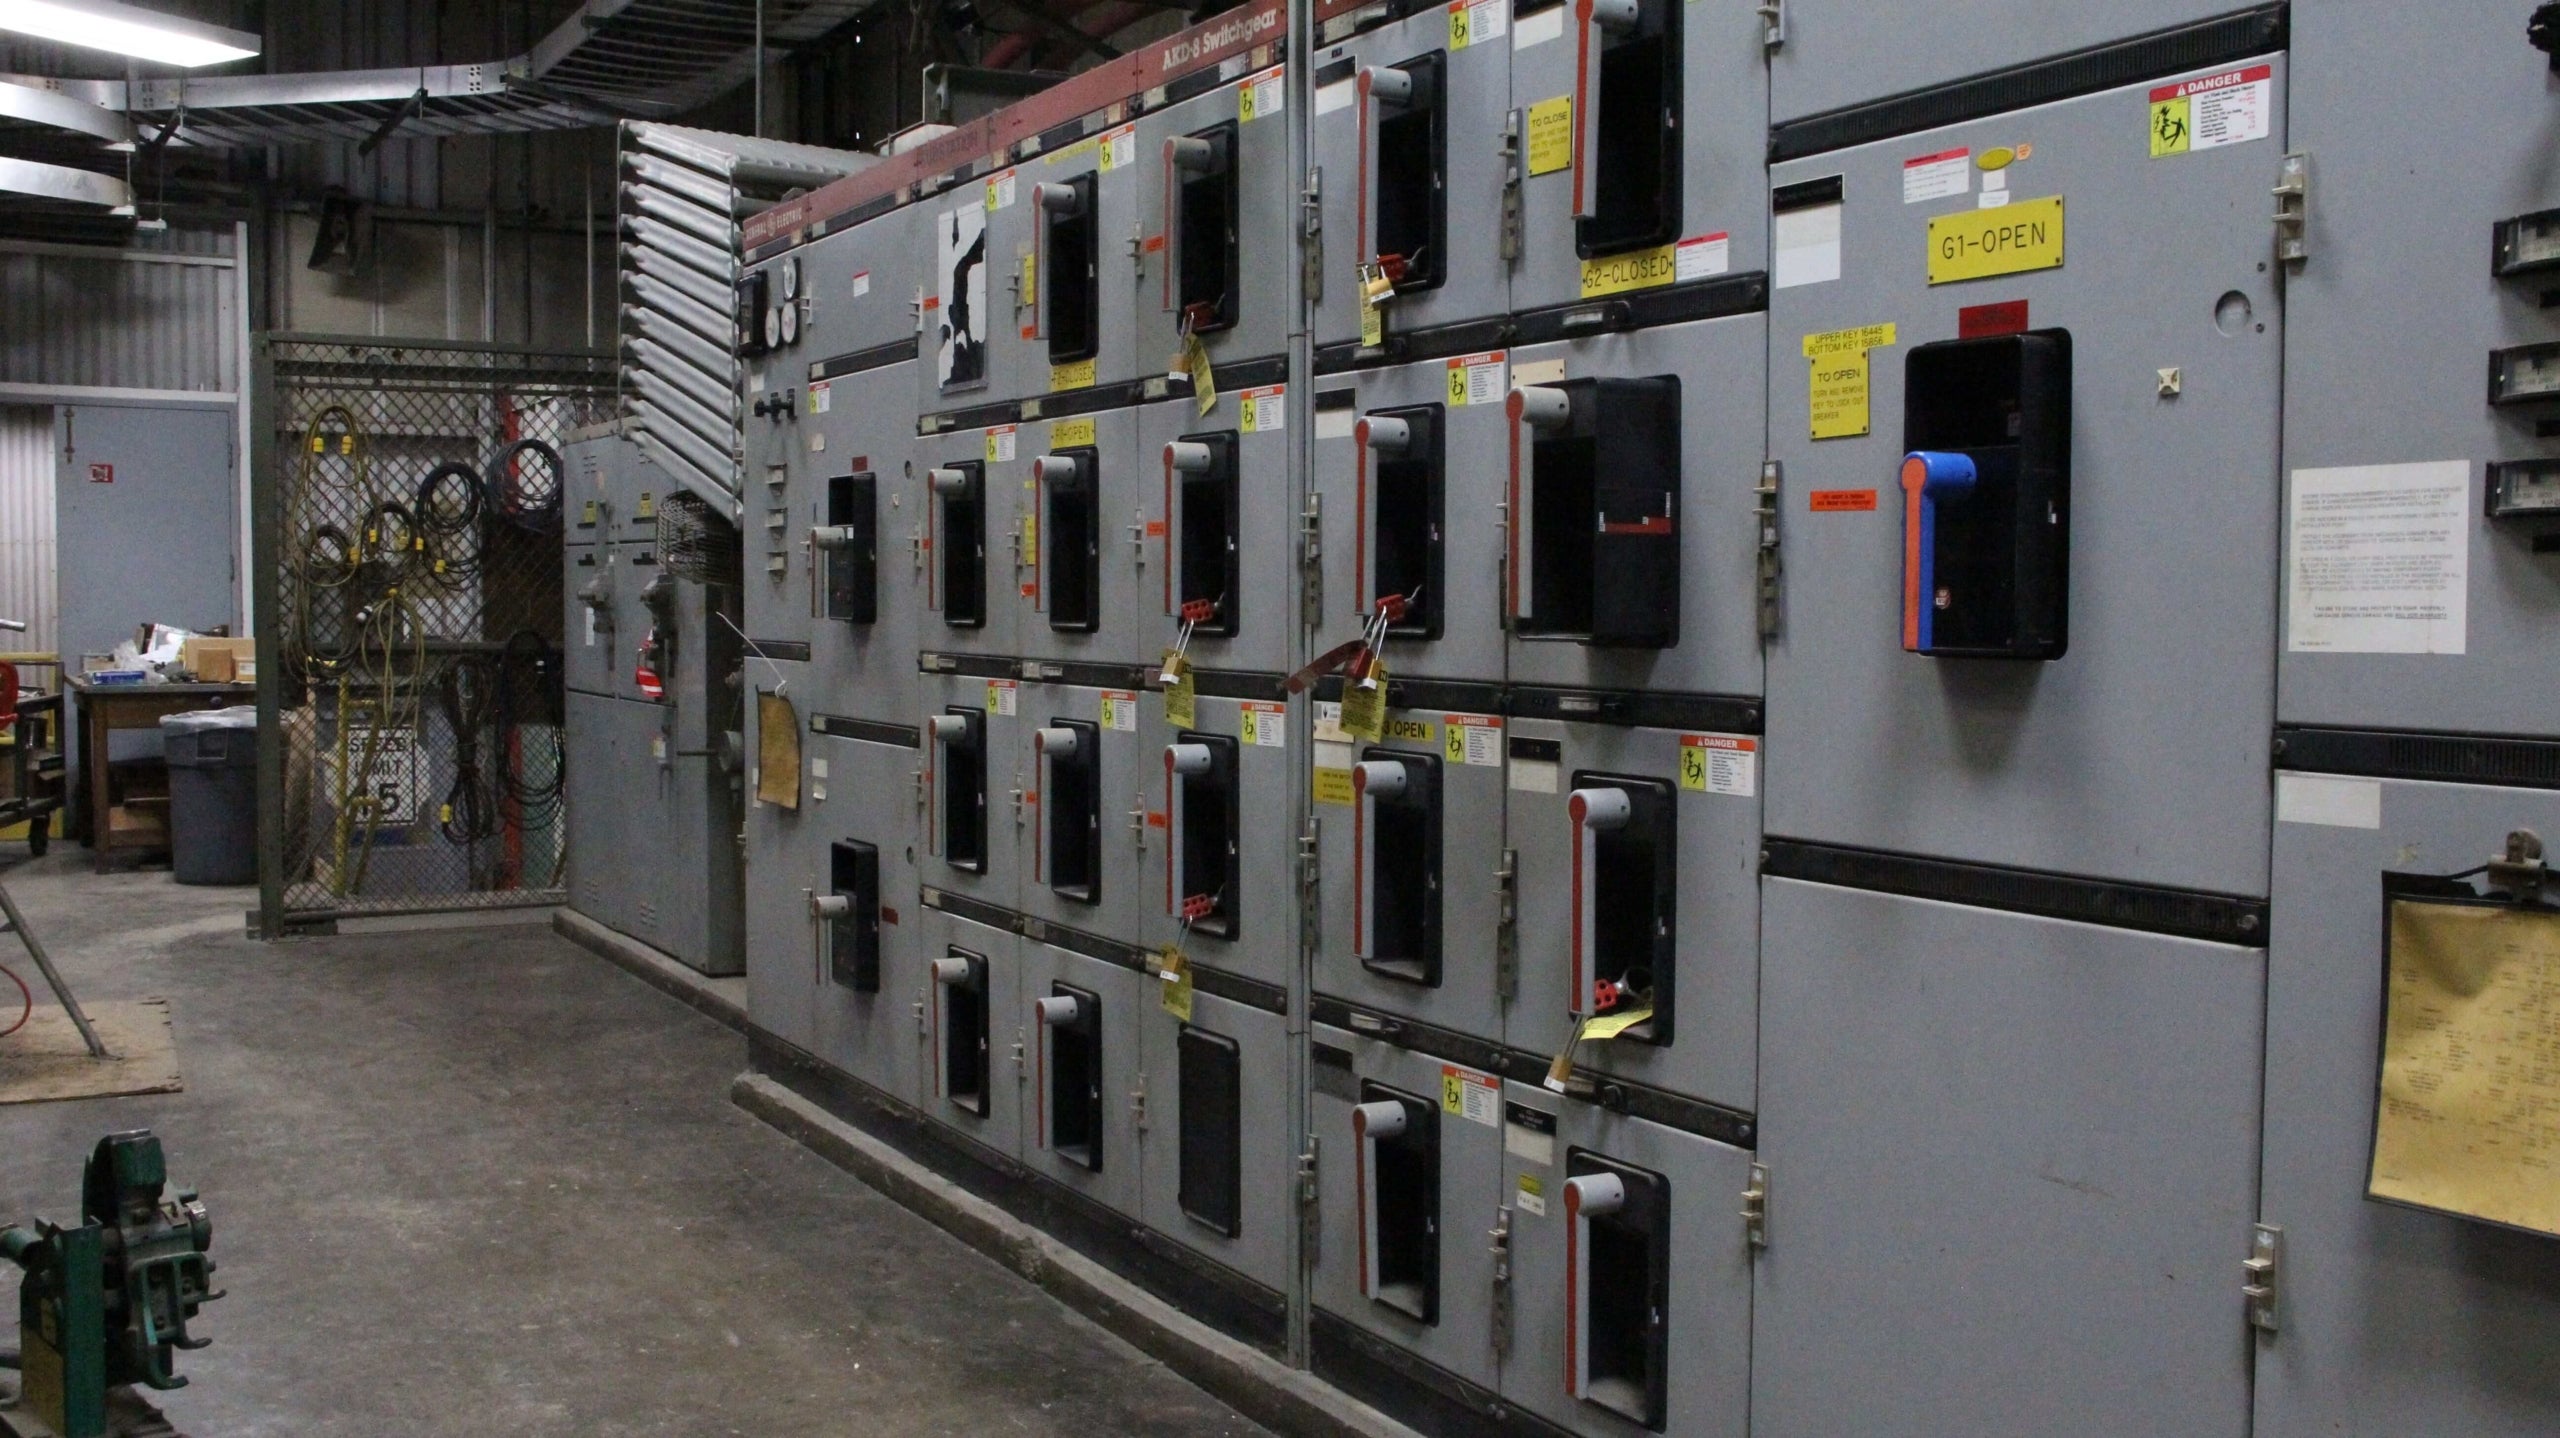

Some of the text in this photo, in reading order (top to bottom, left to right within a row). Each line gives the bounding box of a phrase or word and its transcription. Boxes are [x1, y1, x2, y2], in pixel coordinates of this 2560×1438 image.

[1163, 8, 1277, 71] AKD-8 Switchgear
[2188, 72, 2242, 93] DANGER
[1532, 111, 1568, 128] TO CLOSE
[776, 207, 802, 229] ELECTRIC
[1942, 221, 2046, 260] G1-OPEN
[1585, 255, 1669, 288] G2-CLOSED
[1815, 332, 1841, 344] UPPER
[1843, 329, 1858, 340] KEY
[1808, 344, 1841, 356] BOTTOM
[1843, 340, 1858, 351] KEY
[1465, 354, 1492, 365] DANGER
[1817, 368, 1861, 383] TO OPEN
[1394, 721, 1426, 738] OPEN
[1463, 716, 1489, 726] DANGER
[1704, 738, 1738, 749] DANGER
[355, 758, 403, 775] LMIT
[1460, 1072, 1485, 1085] DANGER
